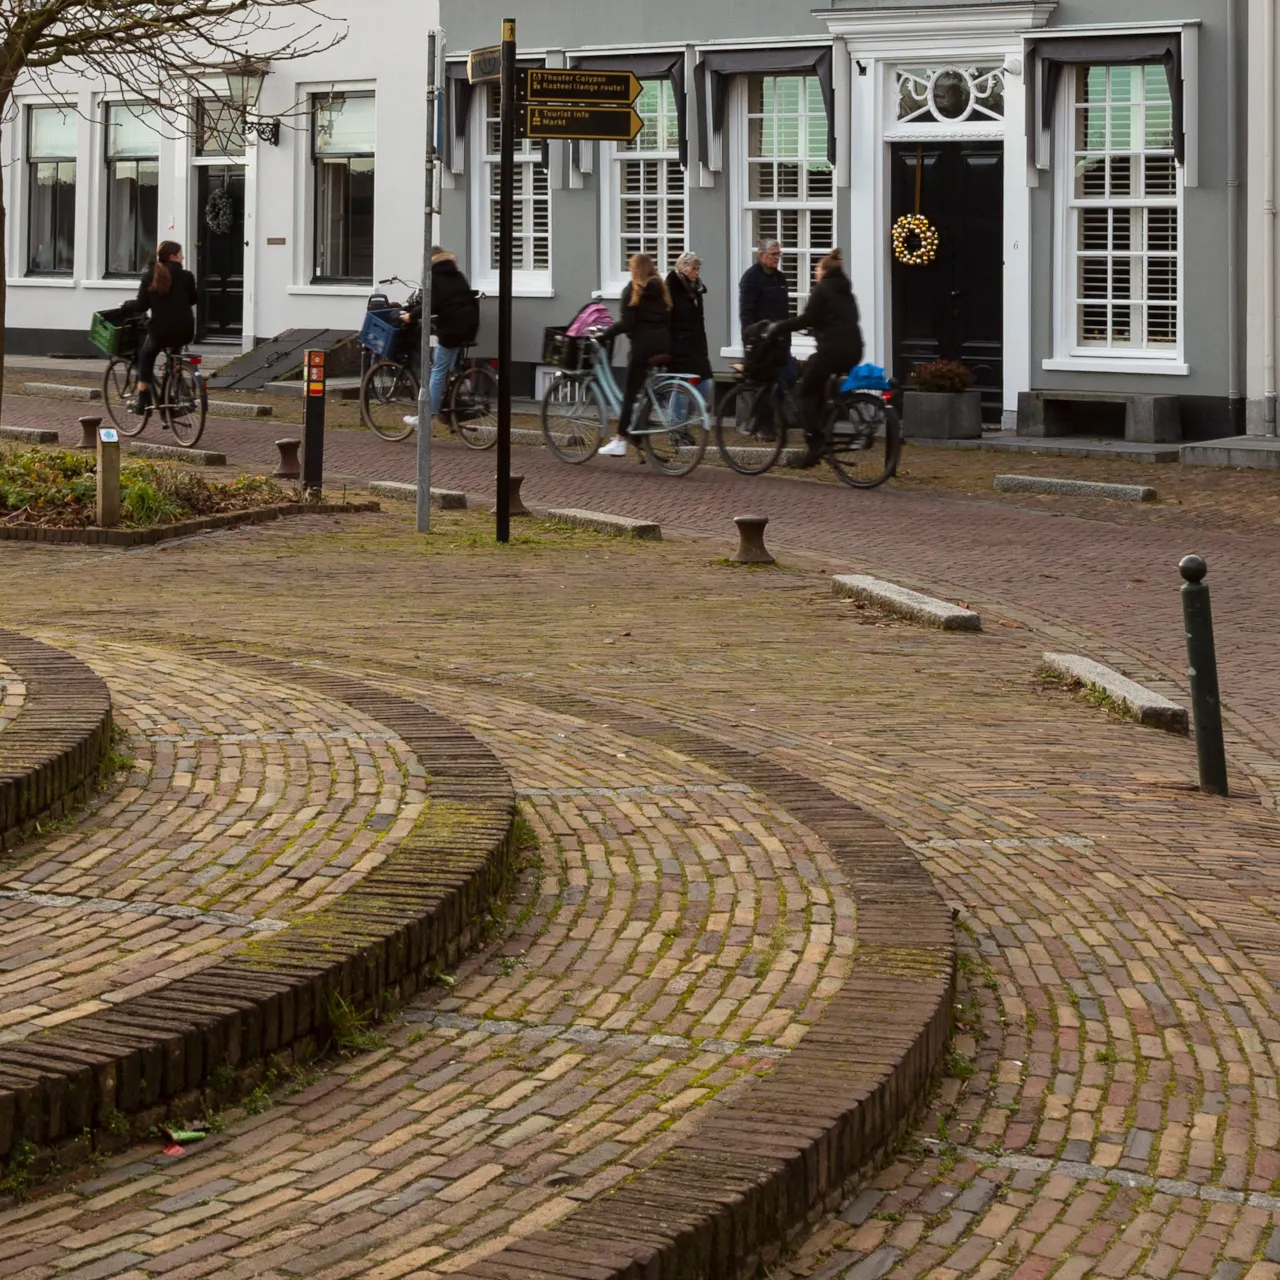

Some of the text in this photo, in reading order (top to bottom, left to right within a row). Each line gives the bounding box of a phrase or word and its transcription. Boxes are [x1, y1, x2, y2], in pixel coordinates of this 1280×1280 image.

[543, 73, 607, 83] Theater Calypso
[542, 82, 625, 92] Kasteel (lange route)
[543, 110, 571, 118] Tourist
